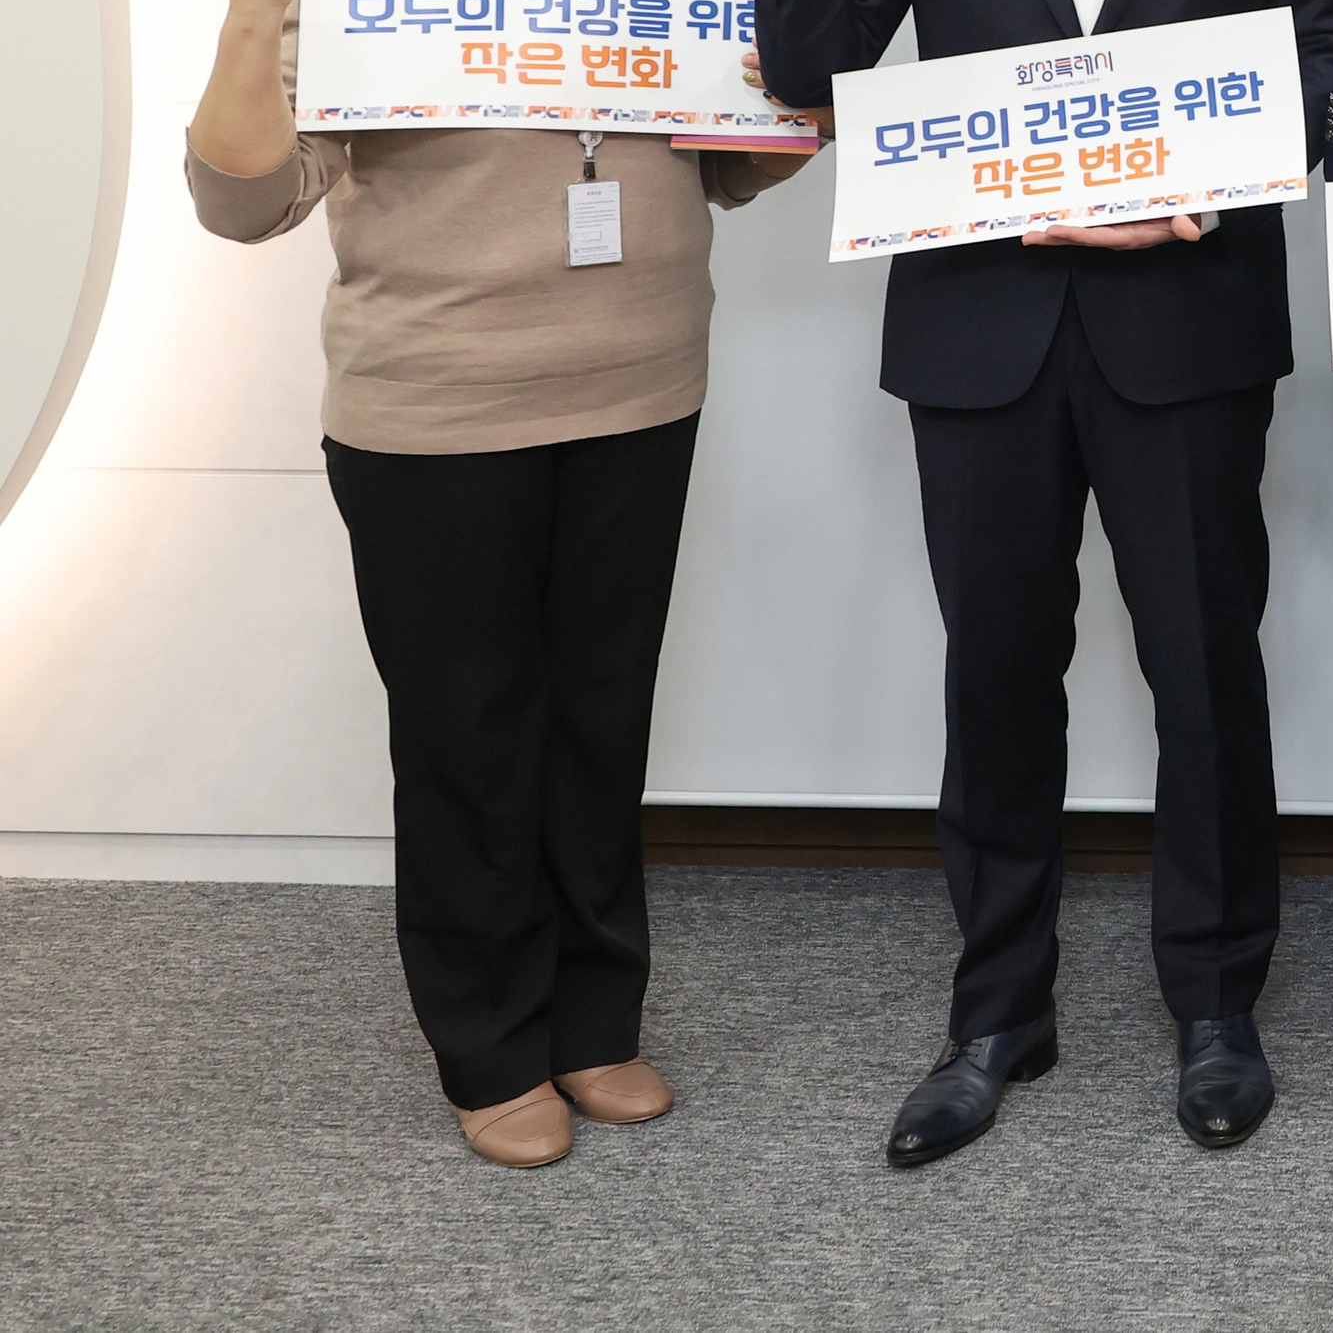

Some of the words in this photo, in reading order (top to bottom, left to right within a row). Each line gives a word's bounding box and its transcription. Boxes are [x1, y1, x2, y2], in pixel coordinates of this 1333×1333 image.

[462, 43, 565, 85] 작은
[582, 45, 678, 88] 변화
[876, 109, 1009, 165] 모두의
[1025, 87, 1159, 144] 건강을
[1175, 72, 1263, 120] 위한
[974, 152, 1062, 198] 작은
[1079, 137, 1170, 187] 변화
